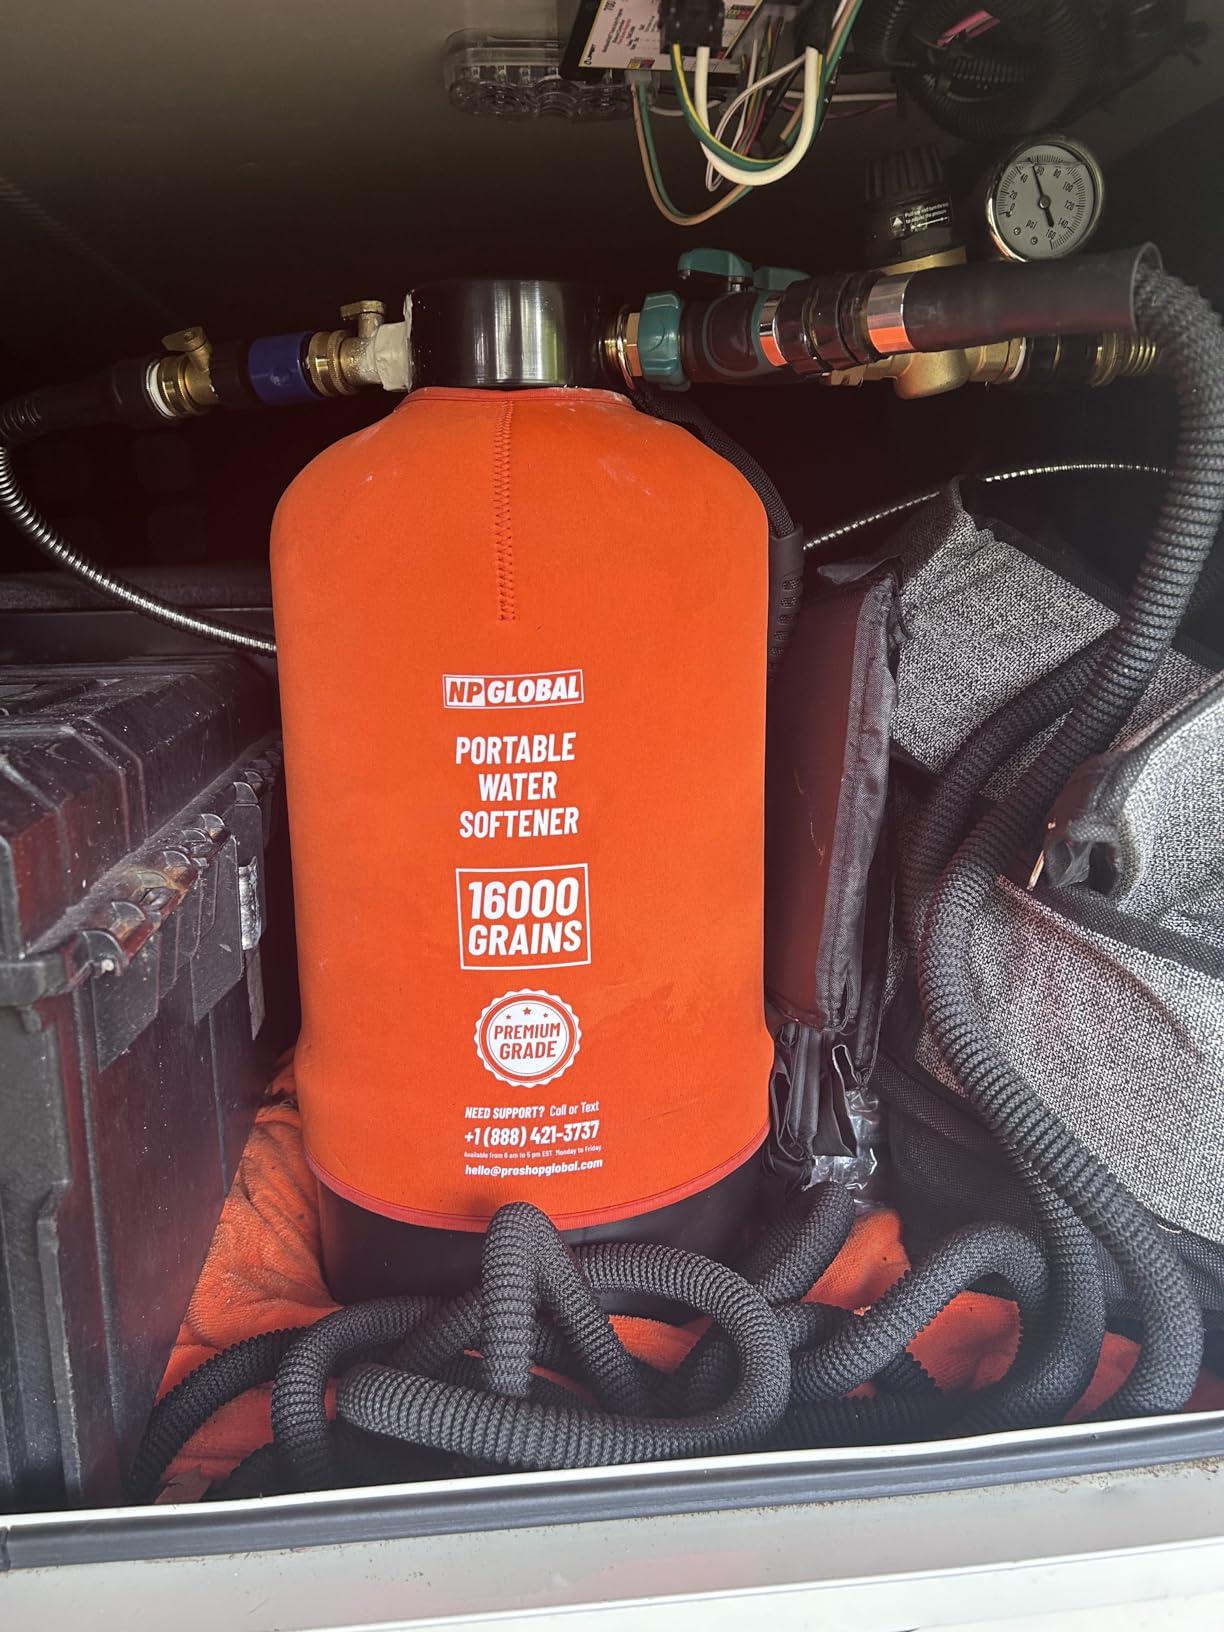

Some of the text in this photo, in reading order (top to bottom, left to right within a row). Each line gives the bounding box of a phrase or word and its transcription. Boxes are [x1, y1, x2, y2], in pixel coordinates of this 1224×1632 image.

[1020, 174, 1029, 183] 40
[1053, 168, 1062, 179] 80
[1009, 190, 1018, 200] 20
[1062, 181, 1074, 193] 100
[1064, 199, 1075, 211] 120
[1025, 219, 1038, 230] psi
[1057, 217, 1069, 229] 140
[1045, 229, 1056, 240] 160
[487, 675, 579, 704] GLOBAL
[455, 731, 577, 765] PORTABLE
[478, 771, 558, 802] WATER
[459, 806, 580, 839] SOFTENER
[468, 876, 579, 920] 16000
[468, 919, 583, 956] GRAINS
[493, 1022, 561, 1041] PREMIUM
[499, 1040, 558, 1061] GRADE
[464, 1100, 600, 1120] NEED SUPPORT? Call or Text
[464, 1119, 600, 1148] +1 (888) 421-3737
[463, 1151, 489, 1159] Available
[531, 1151, 541, 1159] pm
[555, 1148, 577, 1156] Monday
[584, 1144, 602, 1152] Friday
[464, 1159, 603, 1178] hello@proshopglobal.com
